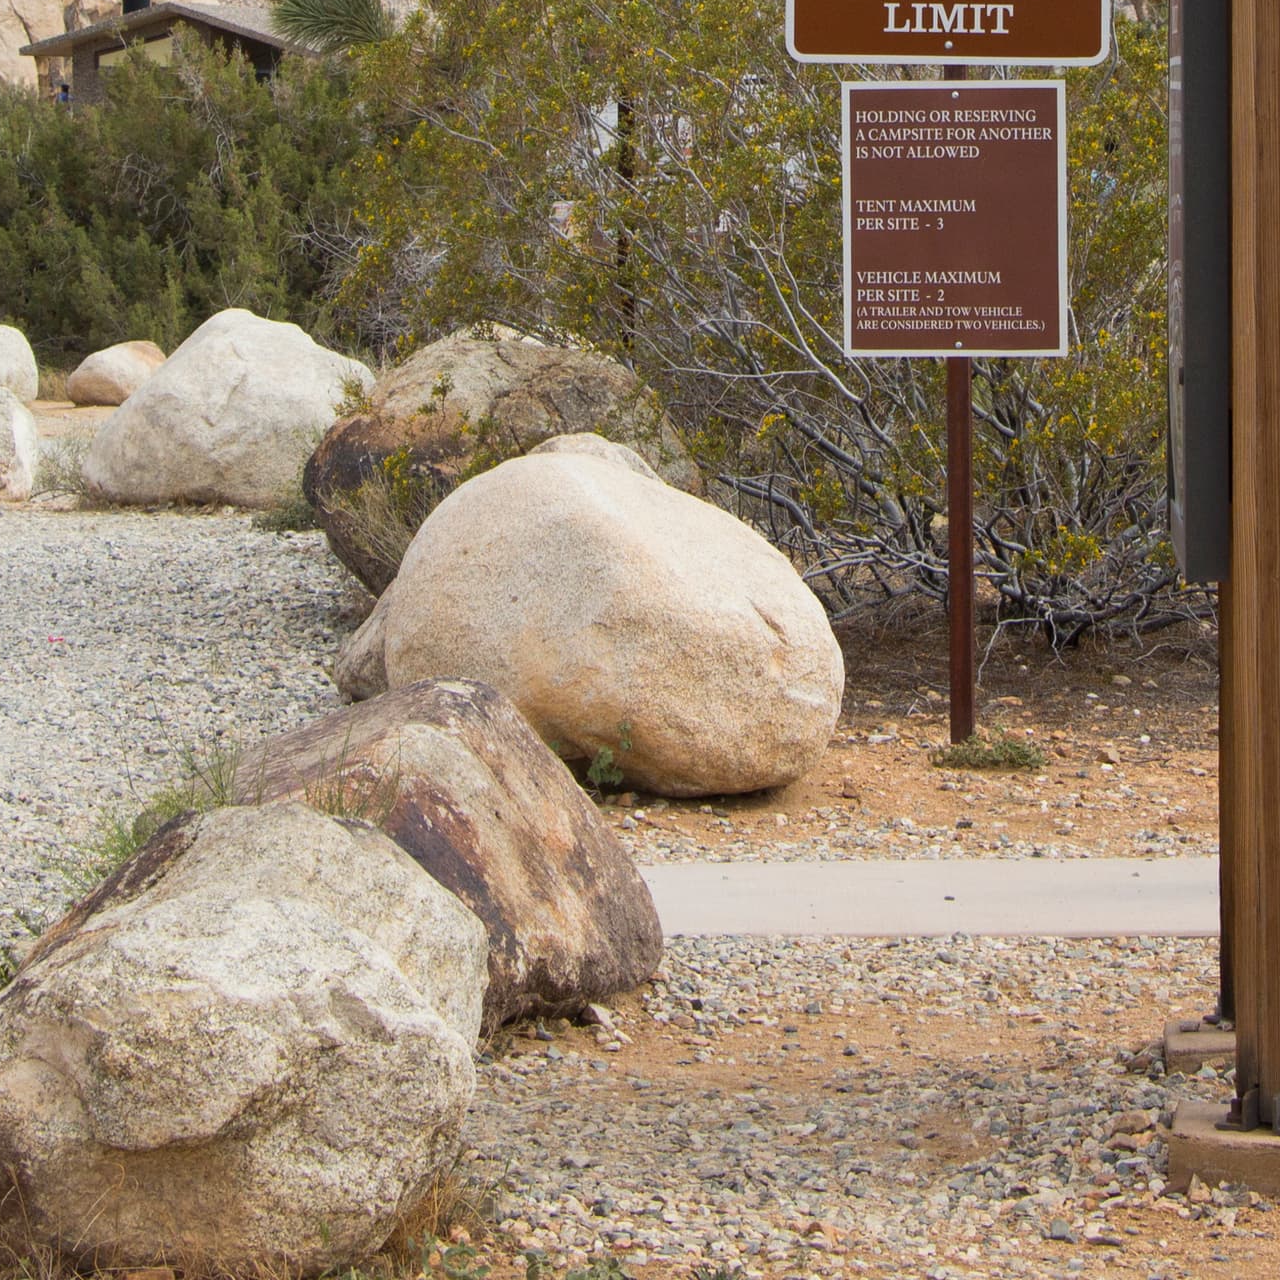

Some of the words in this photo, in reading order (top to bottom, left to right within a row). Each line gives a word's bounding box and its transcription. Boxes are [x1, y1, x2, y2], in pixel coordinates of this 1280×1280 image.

[883, 2, 1013, 33] LIMIT
[855, 109, 926, 123] HOLDING
[928, 109, 951, 122] OR
[953, 108, 1036, 122] RESERVING
[855, 128, 865, 141] A
[867, 127, 943, 141] CAMPSITE
[945, 127, 976, 140] FOR
[978, 126, 1052, 140] ANOTHER
[855, 145, 868, 159] IS
[871, 145, 904, 158] NOT
[905, 145, 979, 158] ALLOWED
[855, 199, 896, 212] TENT
[898, 199, 976, 212] MAXIMUM
[855, 217, 885, 230] PER
[886, 216, 919, 230] SITE
[936, 216, 944, 230] 3
[856, 270, 921, 284] VEHICLE
[924, 270, 1001, 284] MAXIMUM
[856, 288, 885, 302] PER
[887, 288, 920, 302] SITE
[936, 288, 944, 301] 2
[856, 305, 868, 317] (A
[870, 305, 916, 317] TRAILER
[918, 305, 943, 317] AND
[945, 305, 972, 317] TOW
[972, 305, 1023, 317] VEHICLE
[856, 318, 878, 330] ARE
[880, 318, 953, 330] CONSIDERED
[954, 318, 982, 330] TWO
[983, 318, 1045, 332] VEHICLES.)
